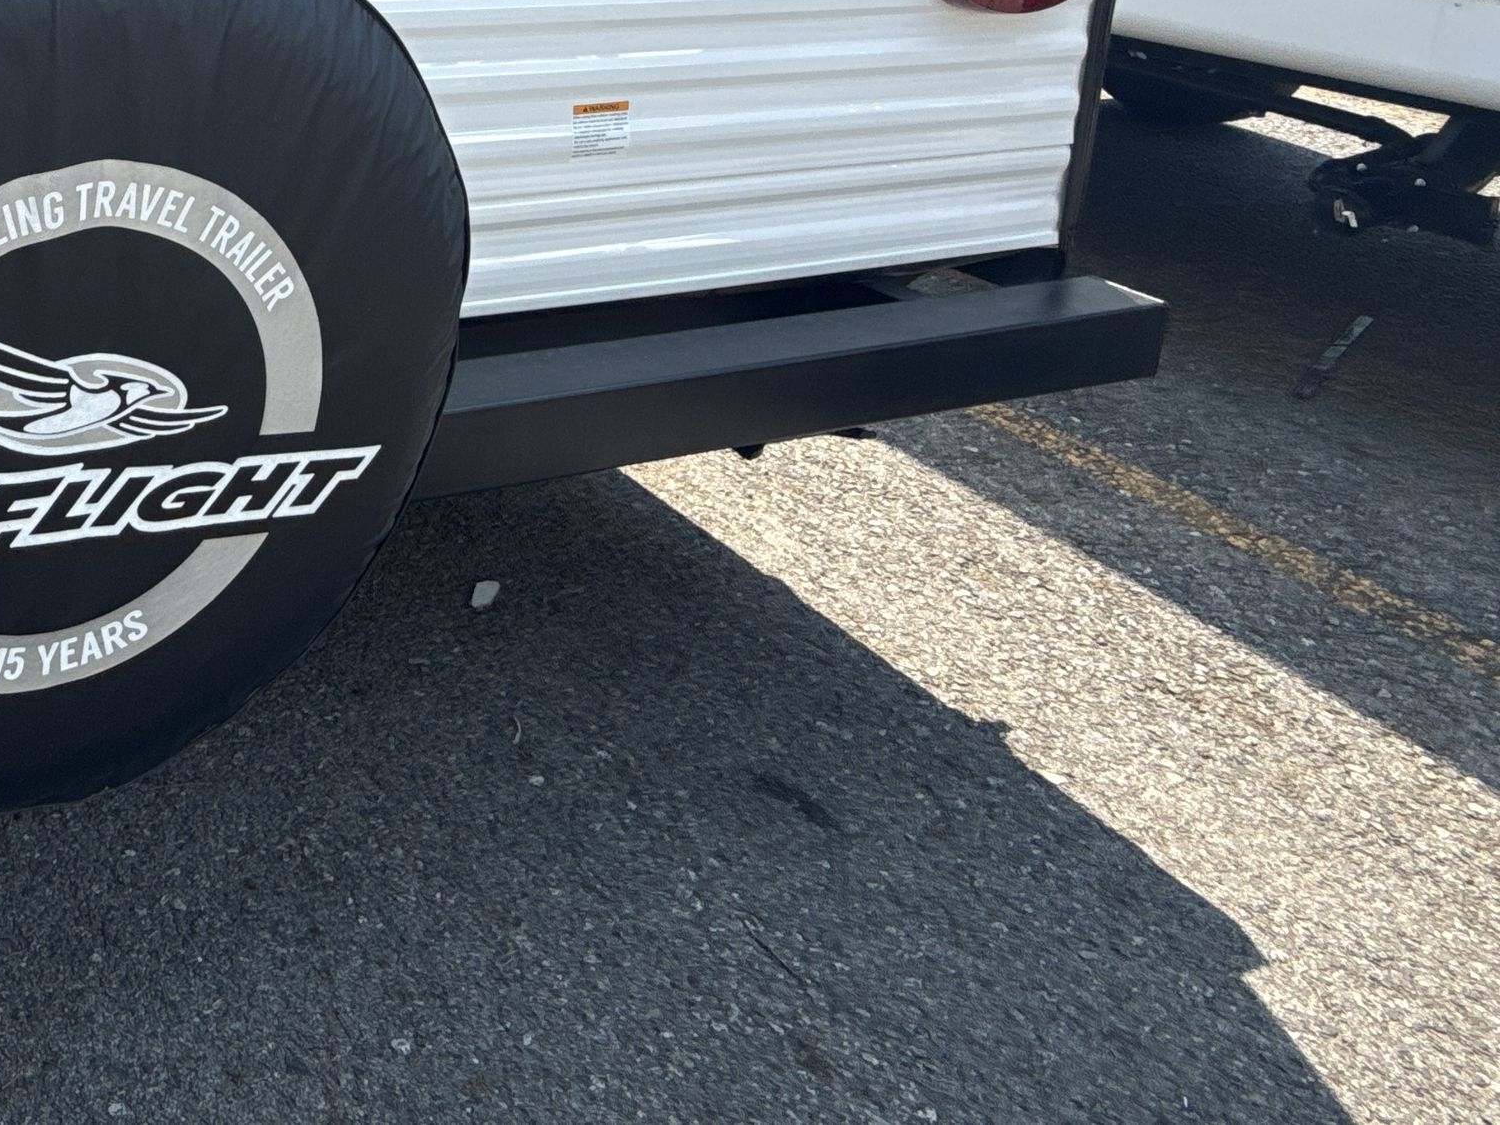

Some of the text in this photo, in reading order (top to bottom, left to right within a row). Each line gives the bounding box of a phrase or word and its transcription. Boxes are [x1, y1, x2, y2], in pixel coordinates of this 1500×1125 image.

[76, 180, 195, 233] TRAVEL
[199, 204, 295, 312] TRAILER
[37, 609, 149, 676] YEARS
